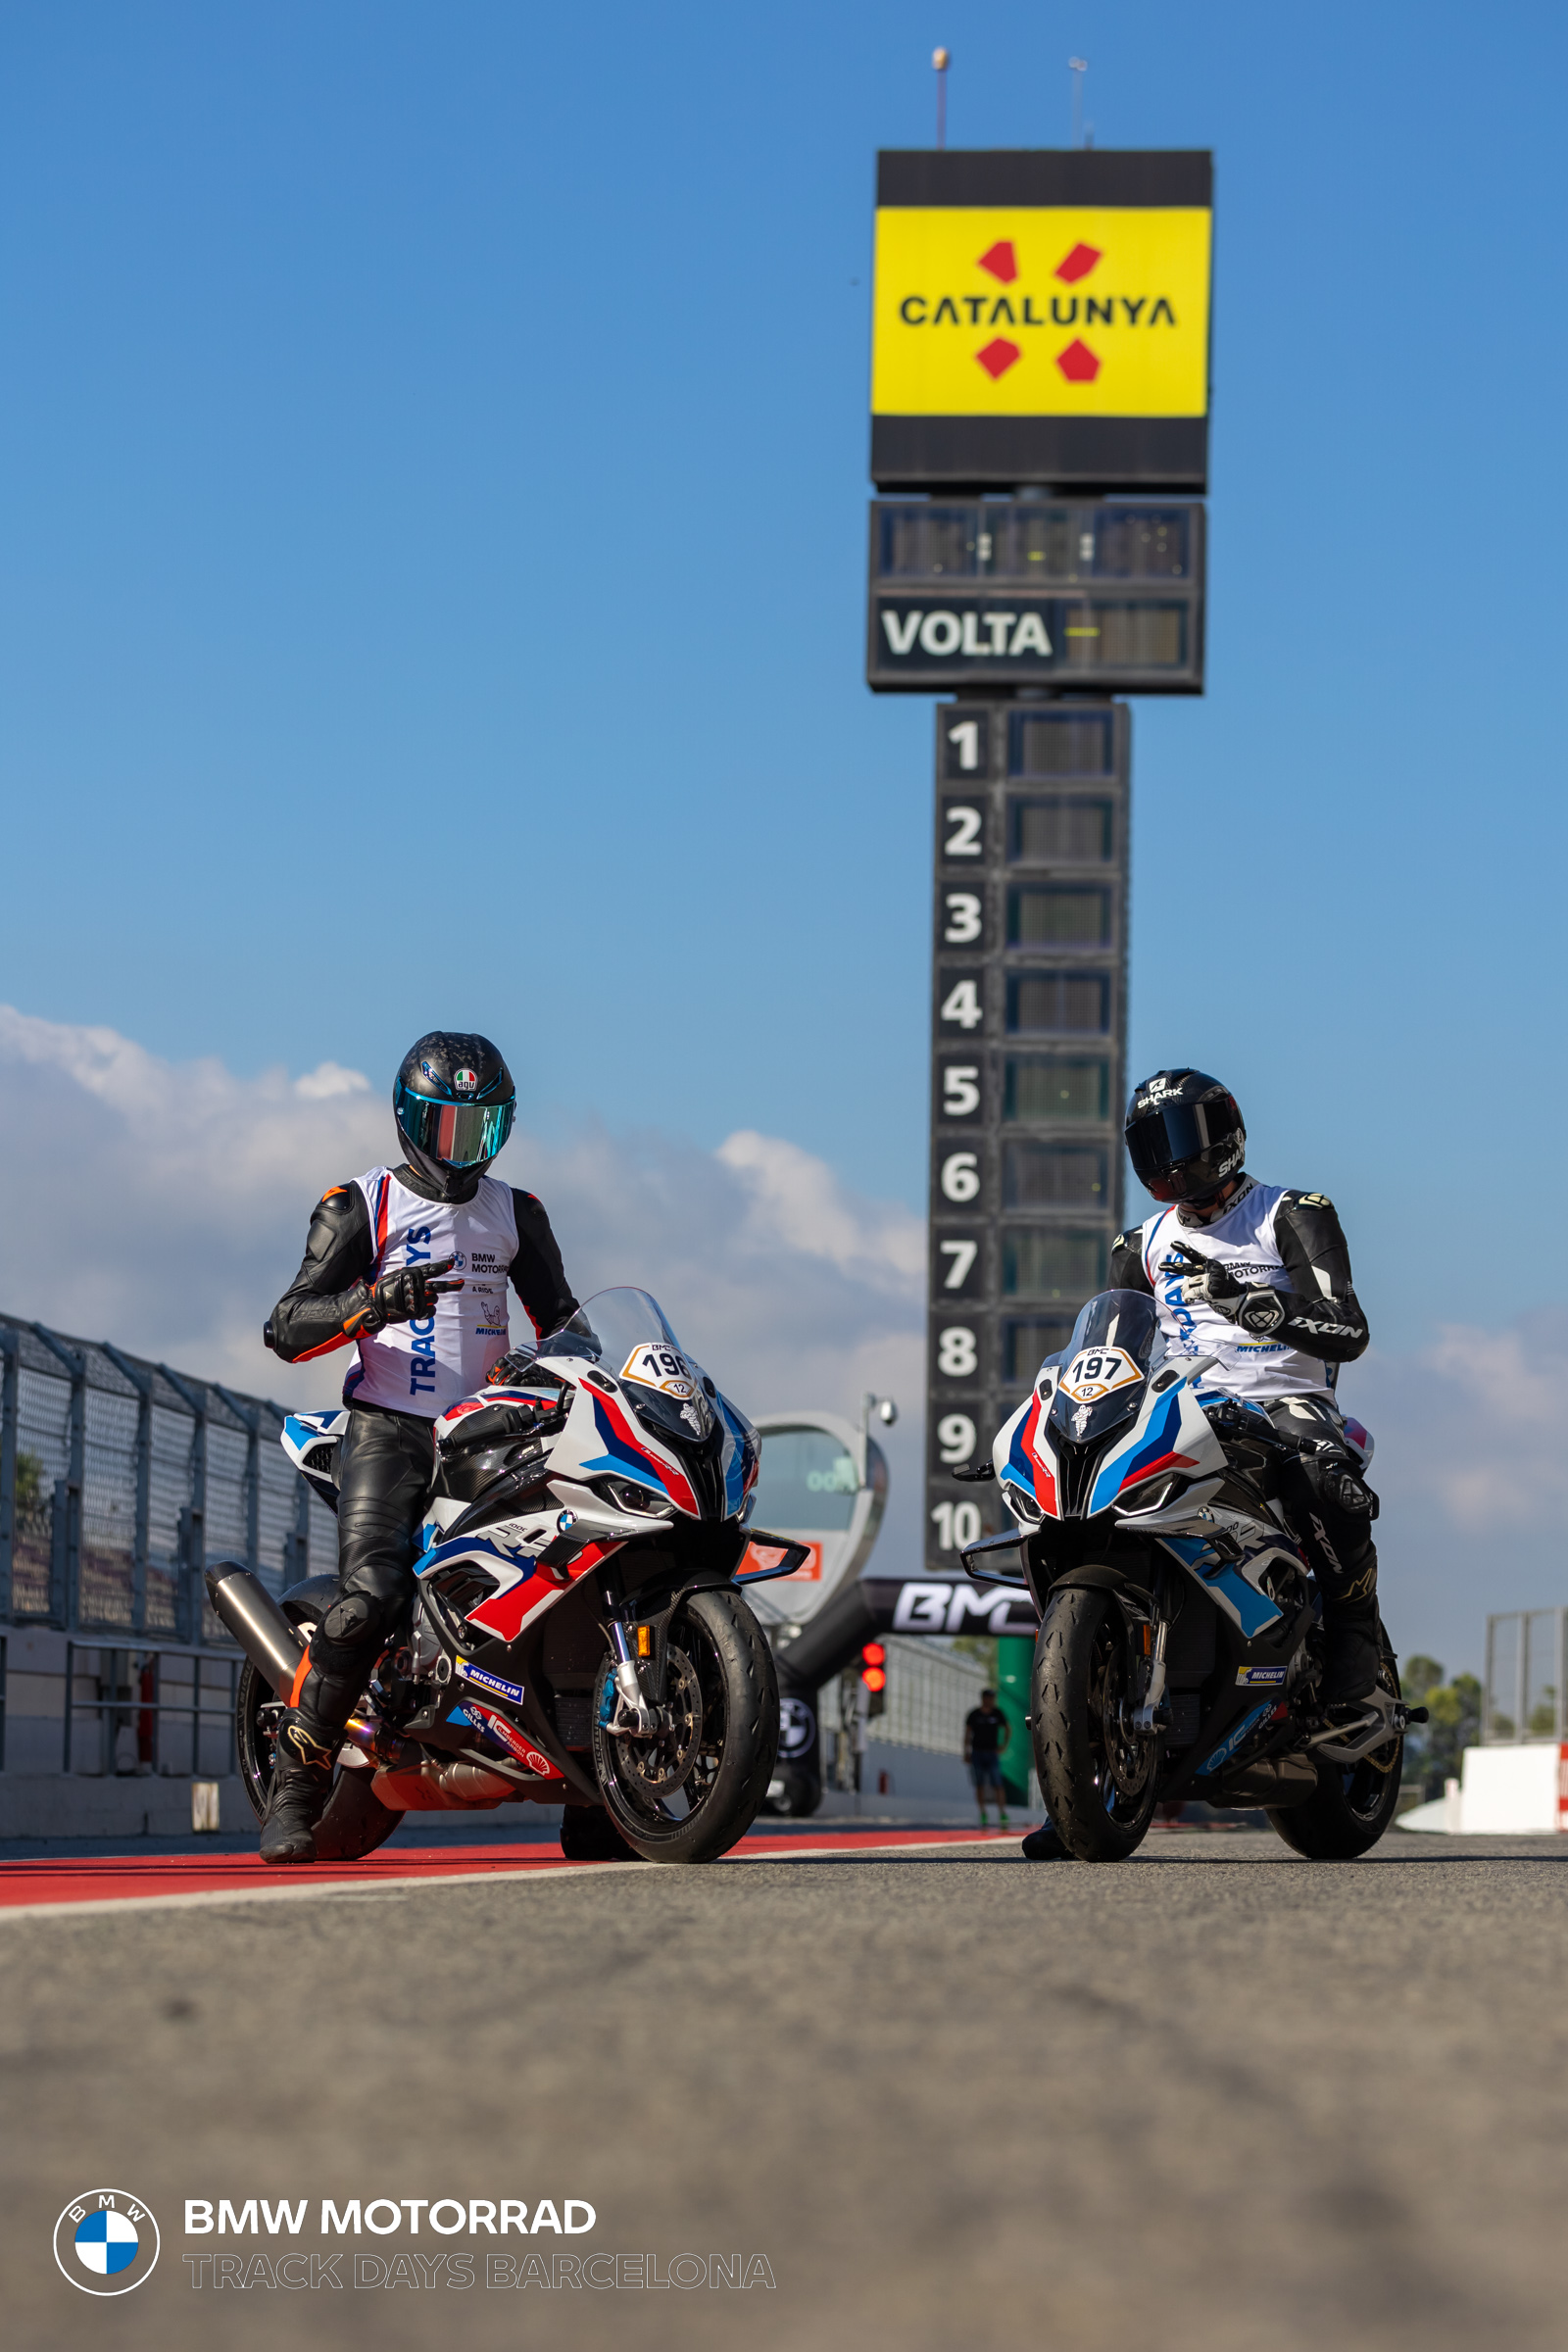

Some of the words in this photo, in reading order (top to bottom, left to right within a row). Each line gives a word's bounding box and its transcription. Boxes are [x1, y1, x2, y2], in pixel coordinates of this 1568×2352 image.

[900, 295, 1177, 327] CATALUNYA
[882, 611, 1054, 657] VOLTA
[948, 720, 979, 769] 1
[944, 806, 982, 856] 2
[944, 893, 982, 943] 3
[941, 980, 982, 1028] 4
[943, 1066, 980, 1116] 5
[1138, 1088, 1183, 1108] SHARK
[941, 1152, 980, 1202] 6
[471, 1253, 496, 1263] BMW
[939, 1241, 978, 1289] 7
[642, 1352, 692, 1381] 196
[938, 1327, 978, 1377] 8
[1237, 1344, 1293, 1353] MICHELI
[673, 1383, 687, 1394] 12
[1072, 1356, 1122, 1383] 197
[1081, 1387, 1094, 1396] 12
[938, 1413, 977, 1464] 9
[931, 1500, 981, 1550] 10
[470, 1669, 520, 1697] MICHELIN
[1251, 1671, 1285, 1680] MICHELIN
[463, 1708, 485, 1733] GILLES
